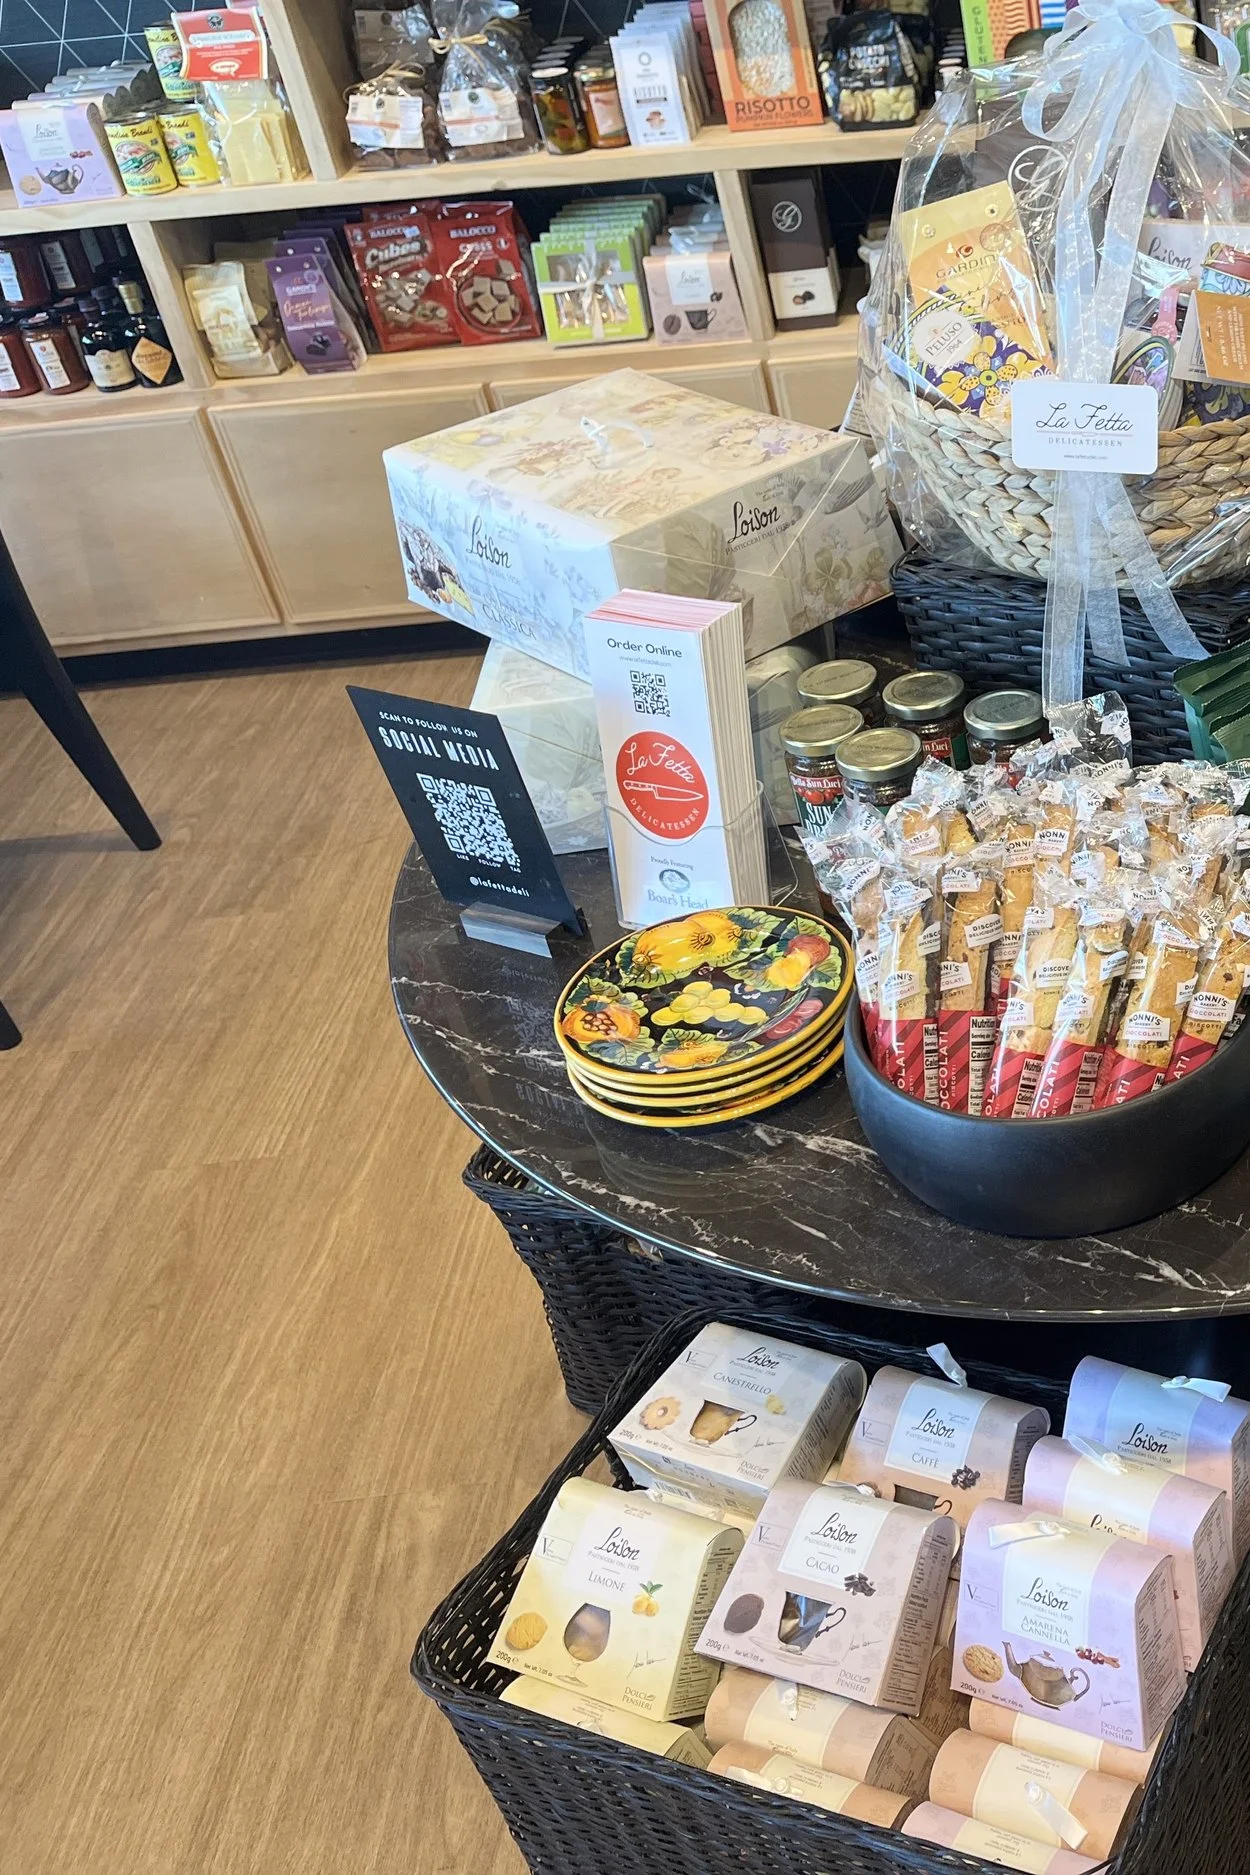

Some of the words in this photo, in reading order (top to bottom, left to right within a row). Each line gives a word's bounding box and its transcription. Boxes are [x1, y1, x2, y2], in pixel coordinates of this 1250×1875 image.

[850, 45, 885, 56] POTATO
[735, 96, 811, 115] RISOTTO
[370, 226, 405, 239] BALOCC
[450, 225, 497, 239] BALOCCO
[365, 240, 422, 266] Cubes
[1150, 237, 1192, 271] Loison
[935, 254, 998, 280] GARDIN
[924, 321, 963, 357] PELUSO
[946, 338, 963, 355] 1964
[1035, 402, 1070, 429] La
[1074, 403, 1134, 432] Fetta
[1048, 437, 1123, 447] DELICATESSEN
[727, 501, 781, 543] Loison
[466, 515, 512, 569] Loison
[482, 603, 537, 641] CLASSICA
[606, 638, 644, 652] Order
[645, 643, 683, 658] Online
[378, 711, 401, 723] SCAN
[402, 715, 414, 726] TO
[415, 719, 449, 734] FOLLOW
[450, 725, 463, 736] US
[464, 727, 478, 739] ON
[378, 726, 442, 759] SOCIAL
[442, 740, 500, 771] MEDIA
[625, 741, 648, 774] La
[649, 742, 696, 784] Fetta
[806, 778, 822, 789] Sun
[822, 778, 841, 790] Luci
[629, 796, 701, 832] DELICATESSEN
[805, 801, 832, 825] SUN
[1039, 831, 1067, 840] NONN
[456, 853, 470, 862] LIKE
[478, 858, 502, 869] FOLLOW
[509, 866, 523, 874] TAG
[469, 875, 531, 899] @lafettadeli
[647, 889, 678, 907] Boar's
[680, 892, 709, 910] Head
[973, 920, 1000, 933] DISCOVE
[857, 955, 880, 973] NONN
[1193, 994, 1229, 1008] NONNI'S
[1128, 1013, 1162, 1027] NONNI'S
[895, 1041, 906, 1091] OLATI
[938, 1030, 950, 1110] OCCOLATI
[1037, 1061, 1061, 1118] COLATI
[736, 1346, 781, 1371] Loison
[713, 1371, 772, 1395] CANESTRELLO
[911, 1408, 955, 1440] Loison
[619, 1430, 636, 1442] 200g
[1121, 1422, 1169, 1455] Loison
[740, 1460, 759, 1473] DOLCI
[911, 1452, 940, 1469] CAFFÈ
[736, 1467, 765, 1481] PENSIERI
[810, 1512, 859, 1544] Loison
[594, 1526, 641, 1561] Loison
[806, 1556, 840, 1575] CACAO
[588, 1571, 627, 1593] LIMONE
[1021, 1577, 1070, 1611] Loison
[1020, 1623, 1071, 1646] CANNELLA
[1022, 1616, 1070, 1637] AMARENA
[706, 1638, 722, 1651] 200g
[495, 1650, 513, 1664] 200g
[836, 1677, 867, 1694] PENSIERI
[839, 1669, 863, 1682] DOLCI
[625, 1686, 648, 1699] DOLCI
[960, 1681, 978, 1694] 200g
[622, 1694, 654, 1710] PENSIERI
[1100, 1722, 1126, 1735] DOLCI
[1100, 1728, 1134, 1743] PENSIERI
